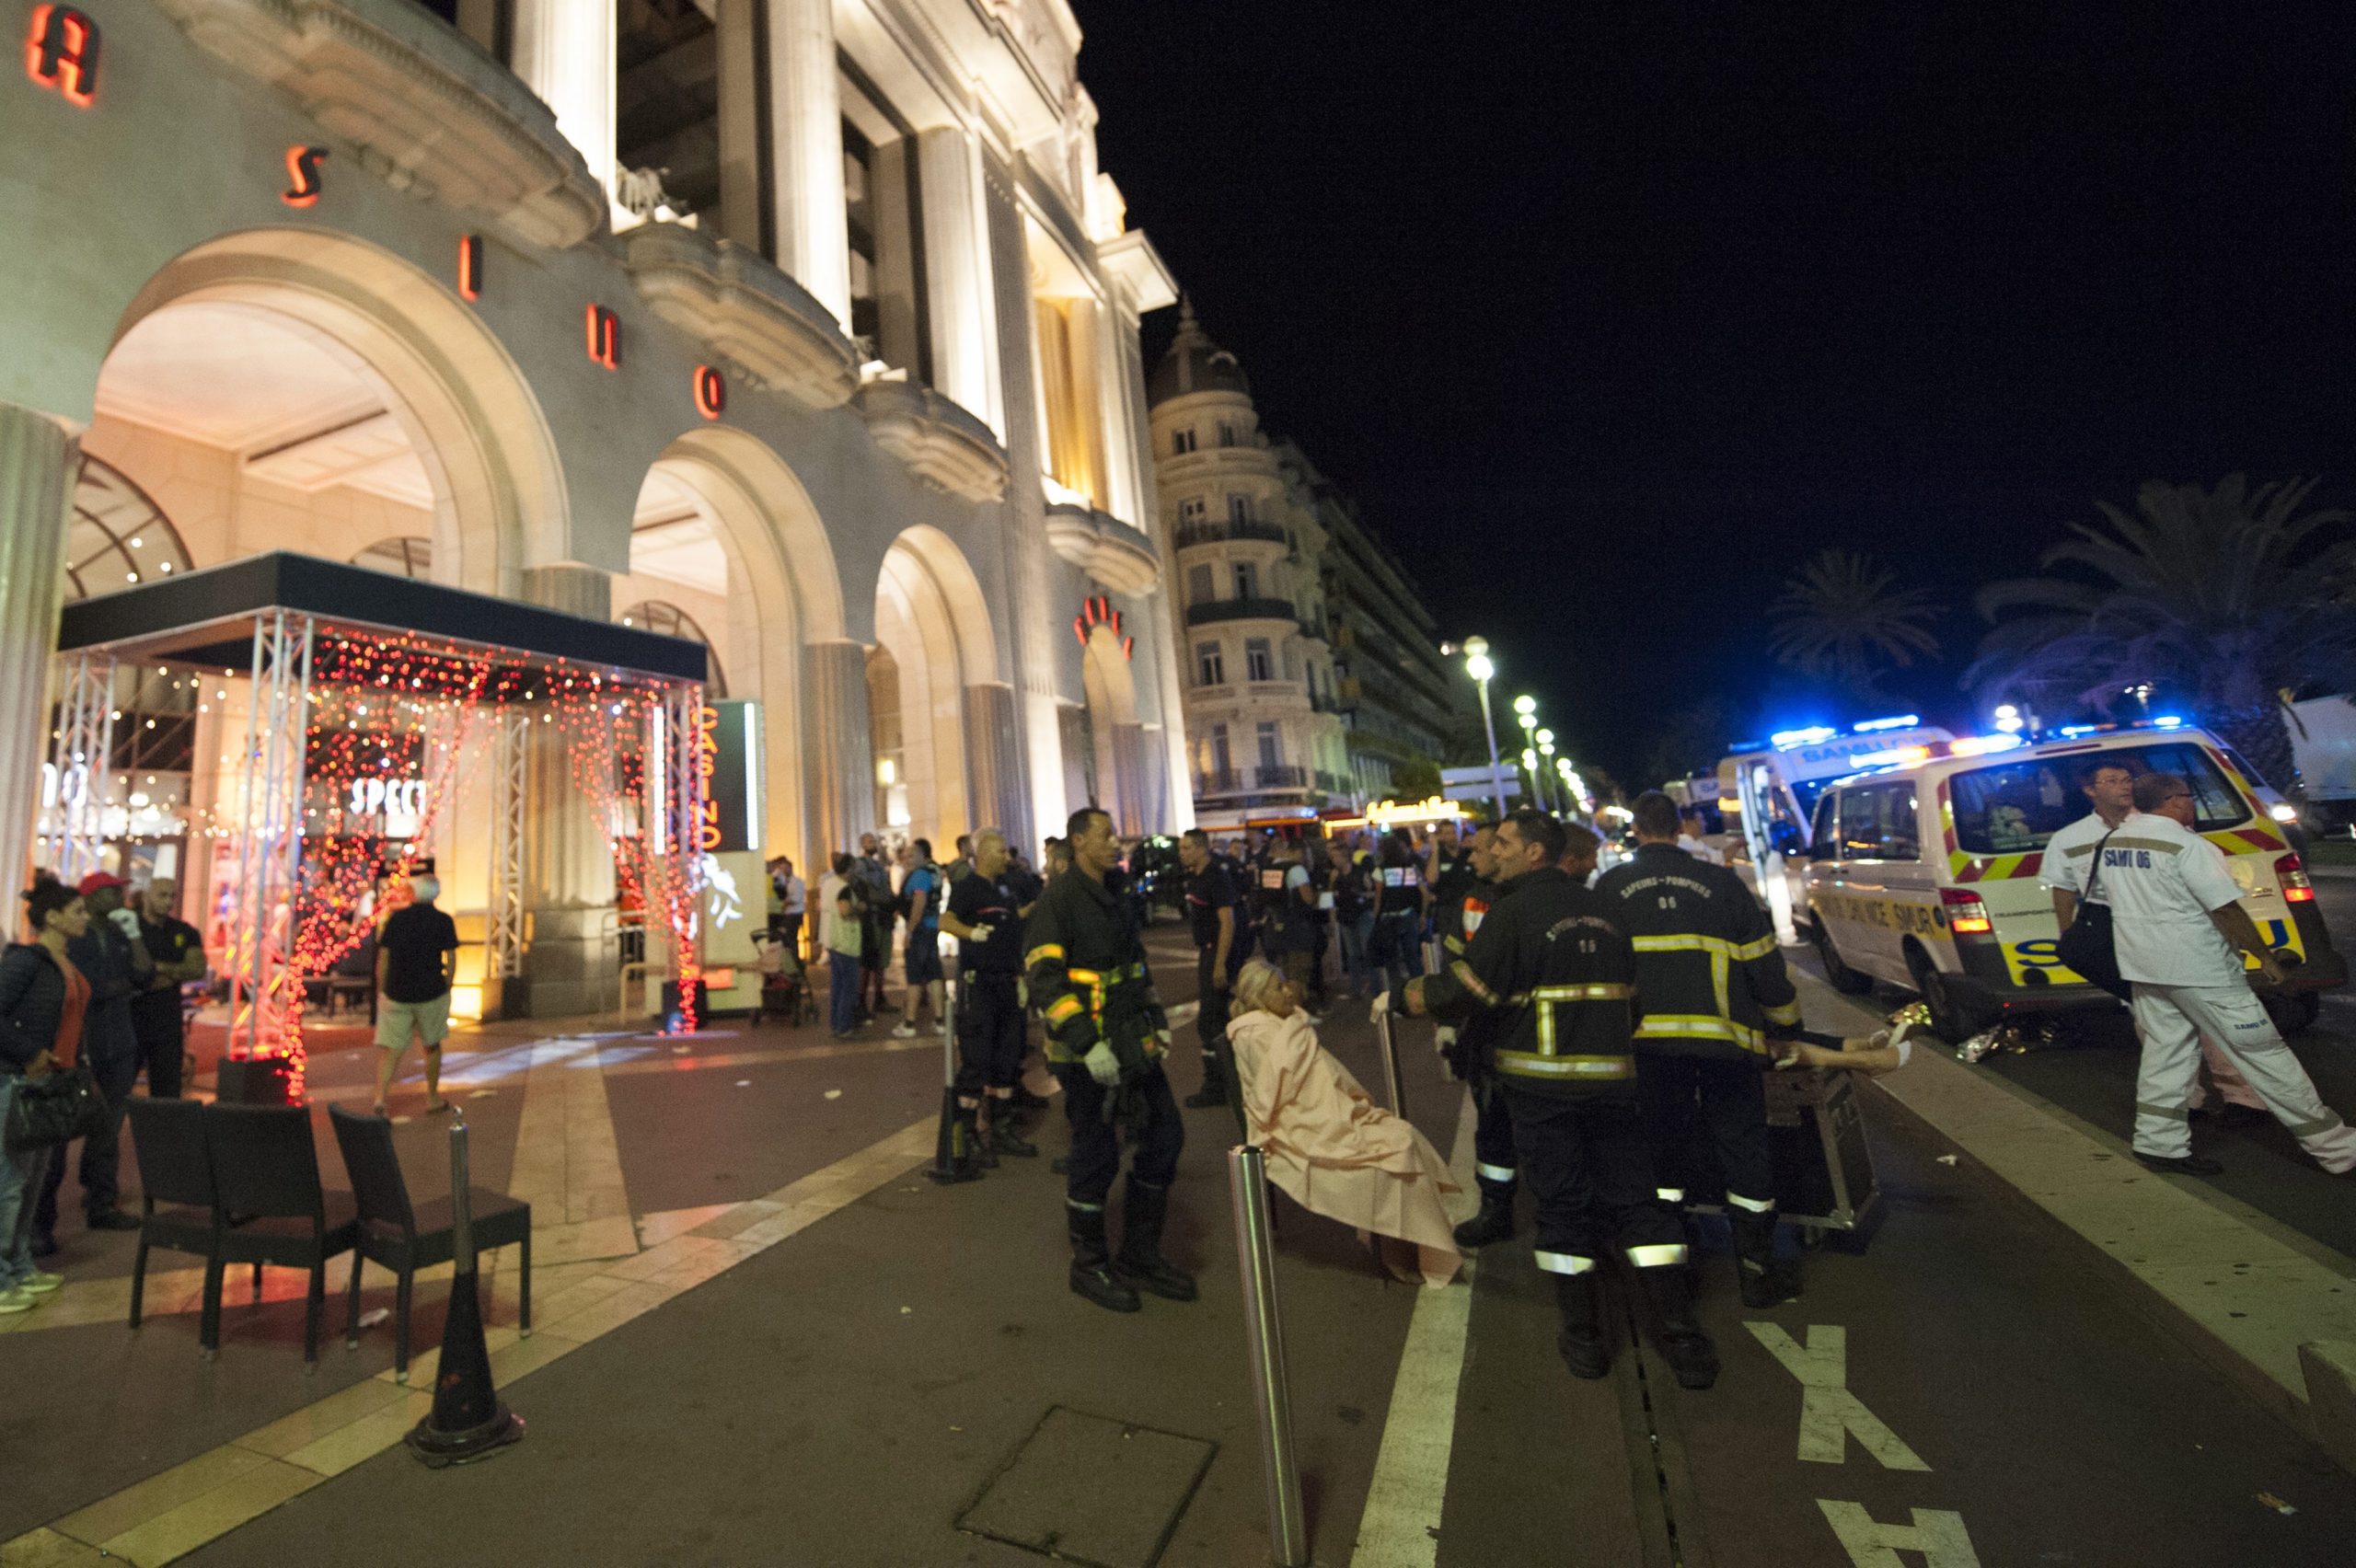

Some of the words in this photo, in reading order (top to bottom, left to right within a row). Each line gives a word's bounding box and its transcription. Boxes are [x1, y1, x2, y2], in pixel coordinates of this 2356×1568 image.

[691, 706, 722, 850] CASINO
[2104, 849, 2133, 867] SAMU
[2136, 850, 2151, 869] 06
